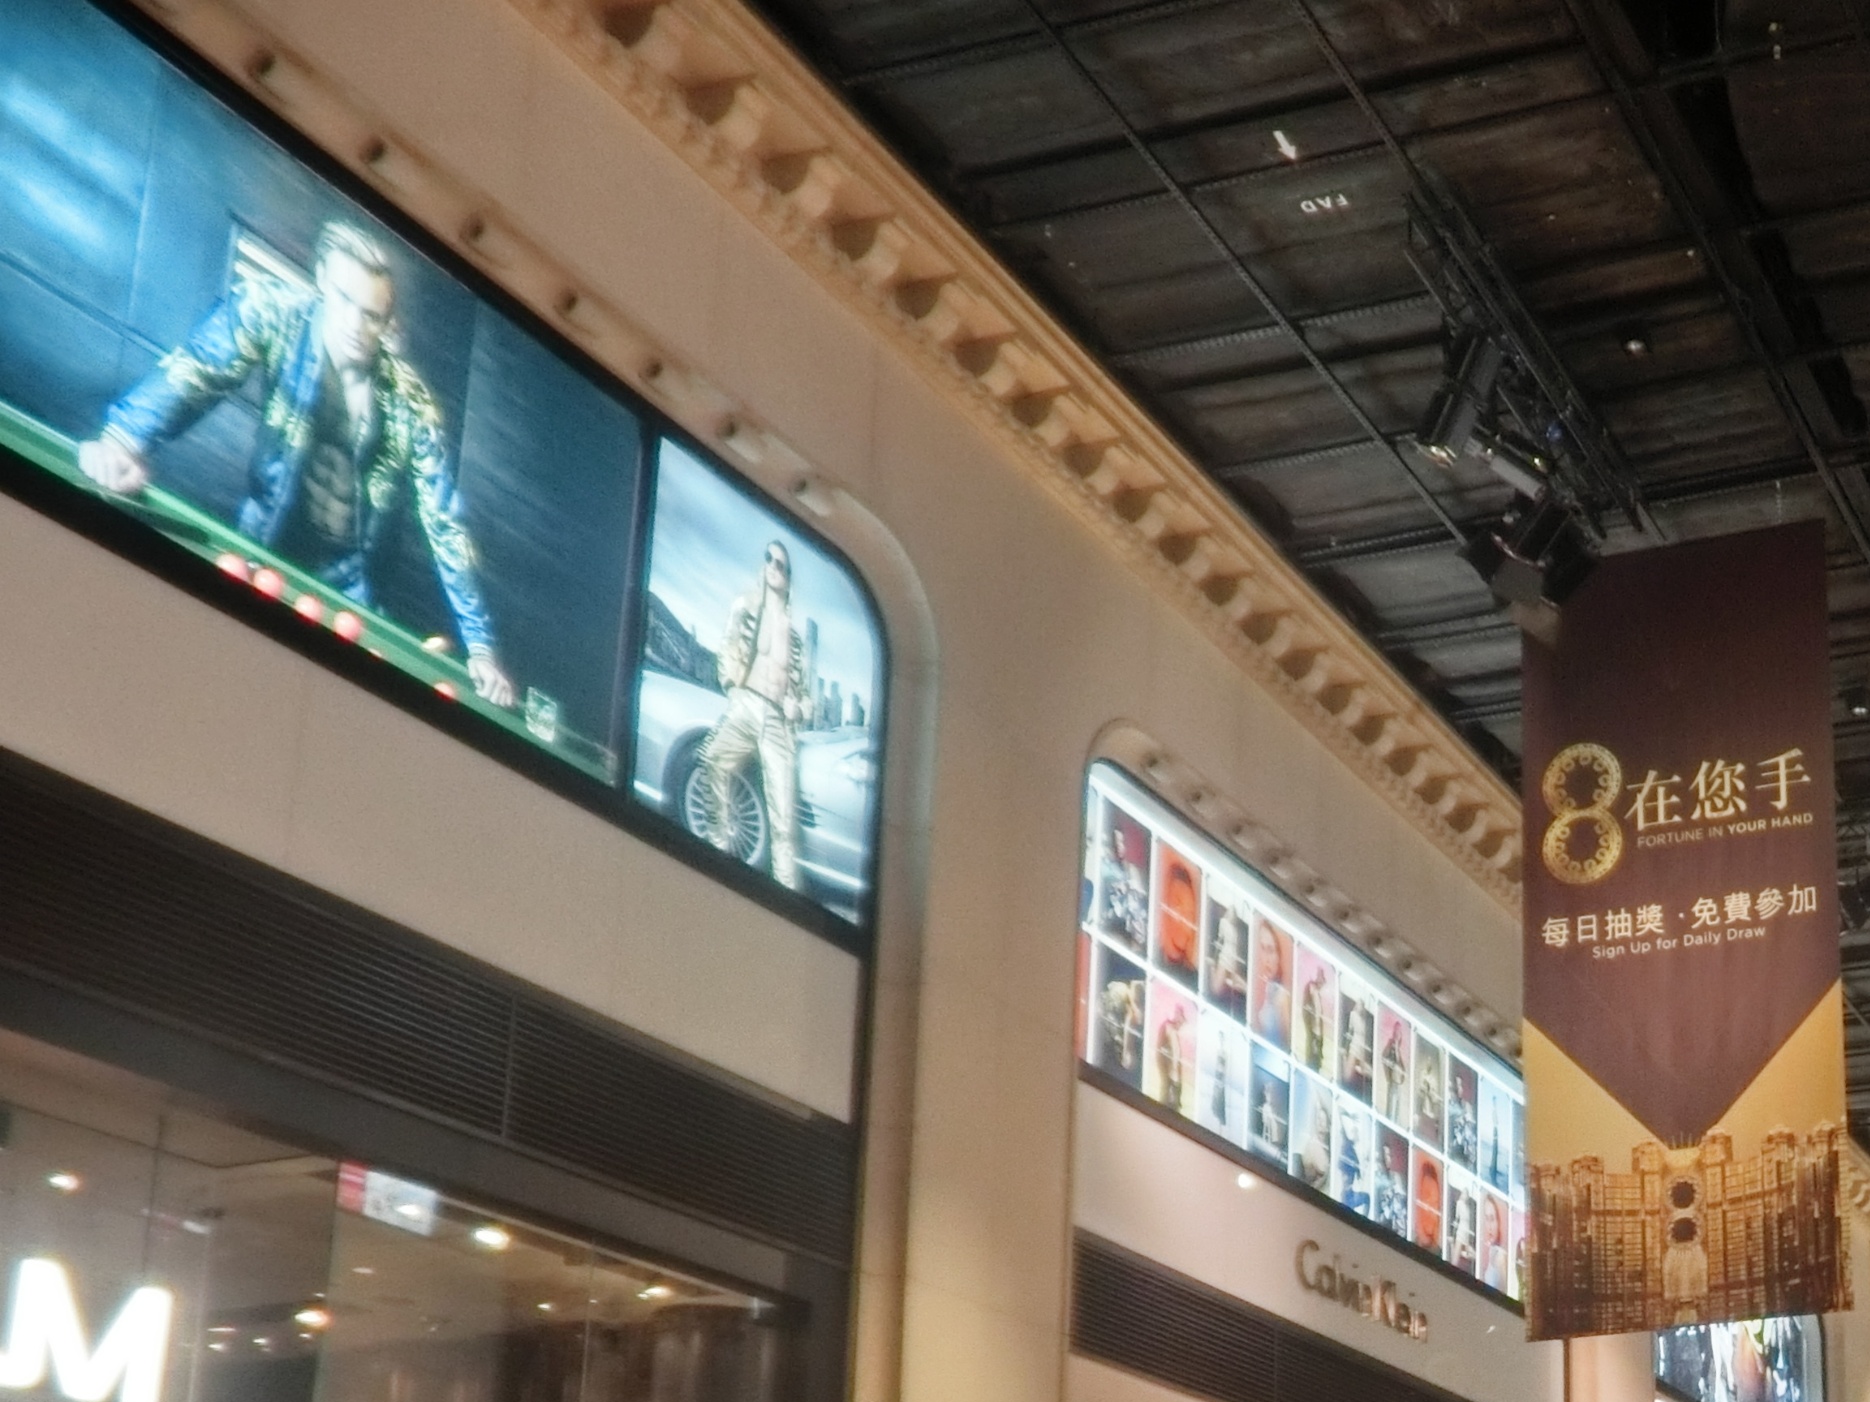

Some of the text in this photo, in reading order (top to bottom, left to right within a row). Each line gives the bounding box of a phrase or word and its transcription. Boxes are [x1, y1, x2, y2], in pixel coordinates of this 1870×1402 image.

[1637, 812, 1813, 848] FORTUNE IN YOUR HAND
[1592, 924, 1766, 960] Sign Up for Daily Draw
